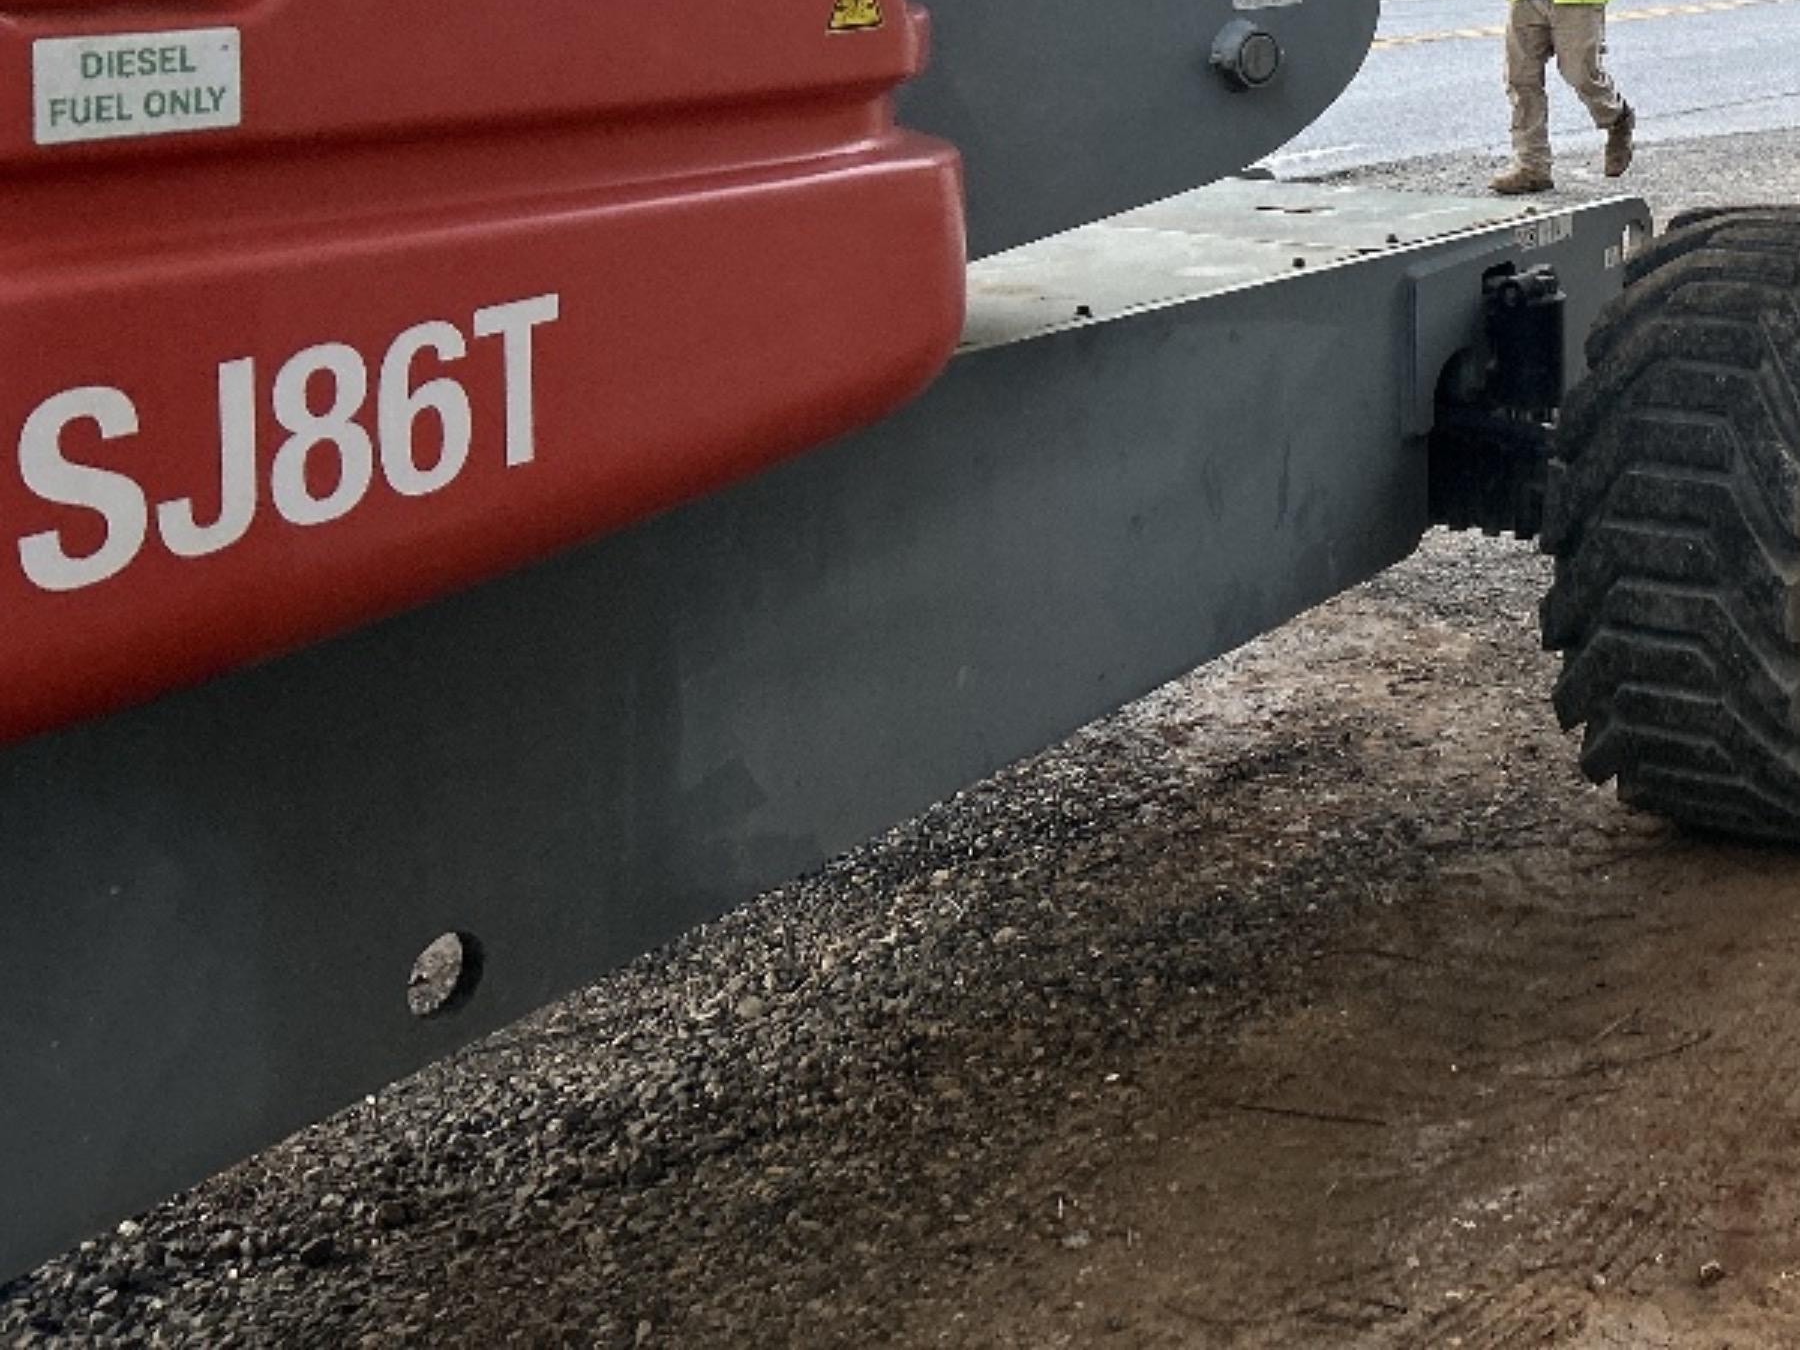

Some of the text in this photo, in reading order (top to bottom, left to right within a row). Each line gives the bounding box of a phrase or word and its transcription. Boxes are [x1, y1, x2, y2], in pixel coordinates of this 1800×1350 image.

[80, 44, 197, 80] DIESEL
[48, 86, 227, 127] FUEL ONLY
[16, 292, 560, 592] SJ86T
